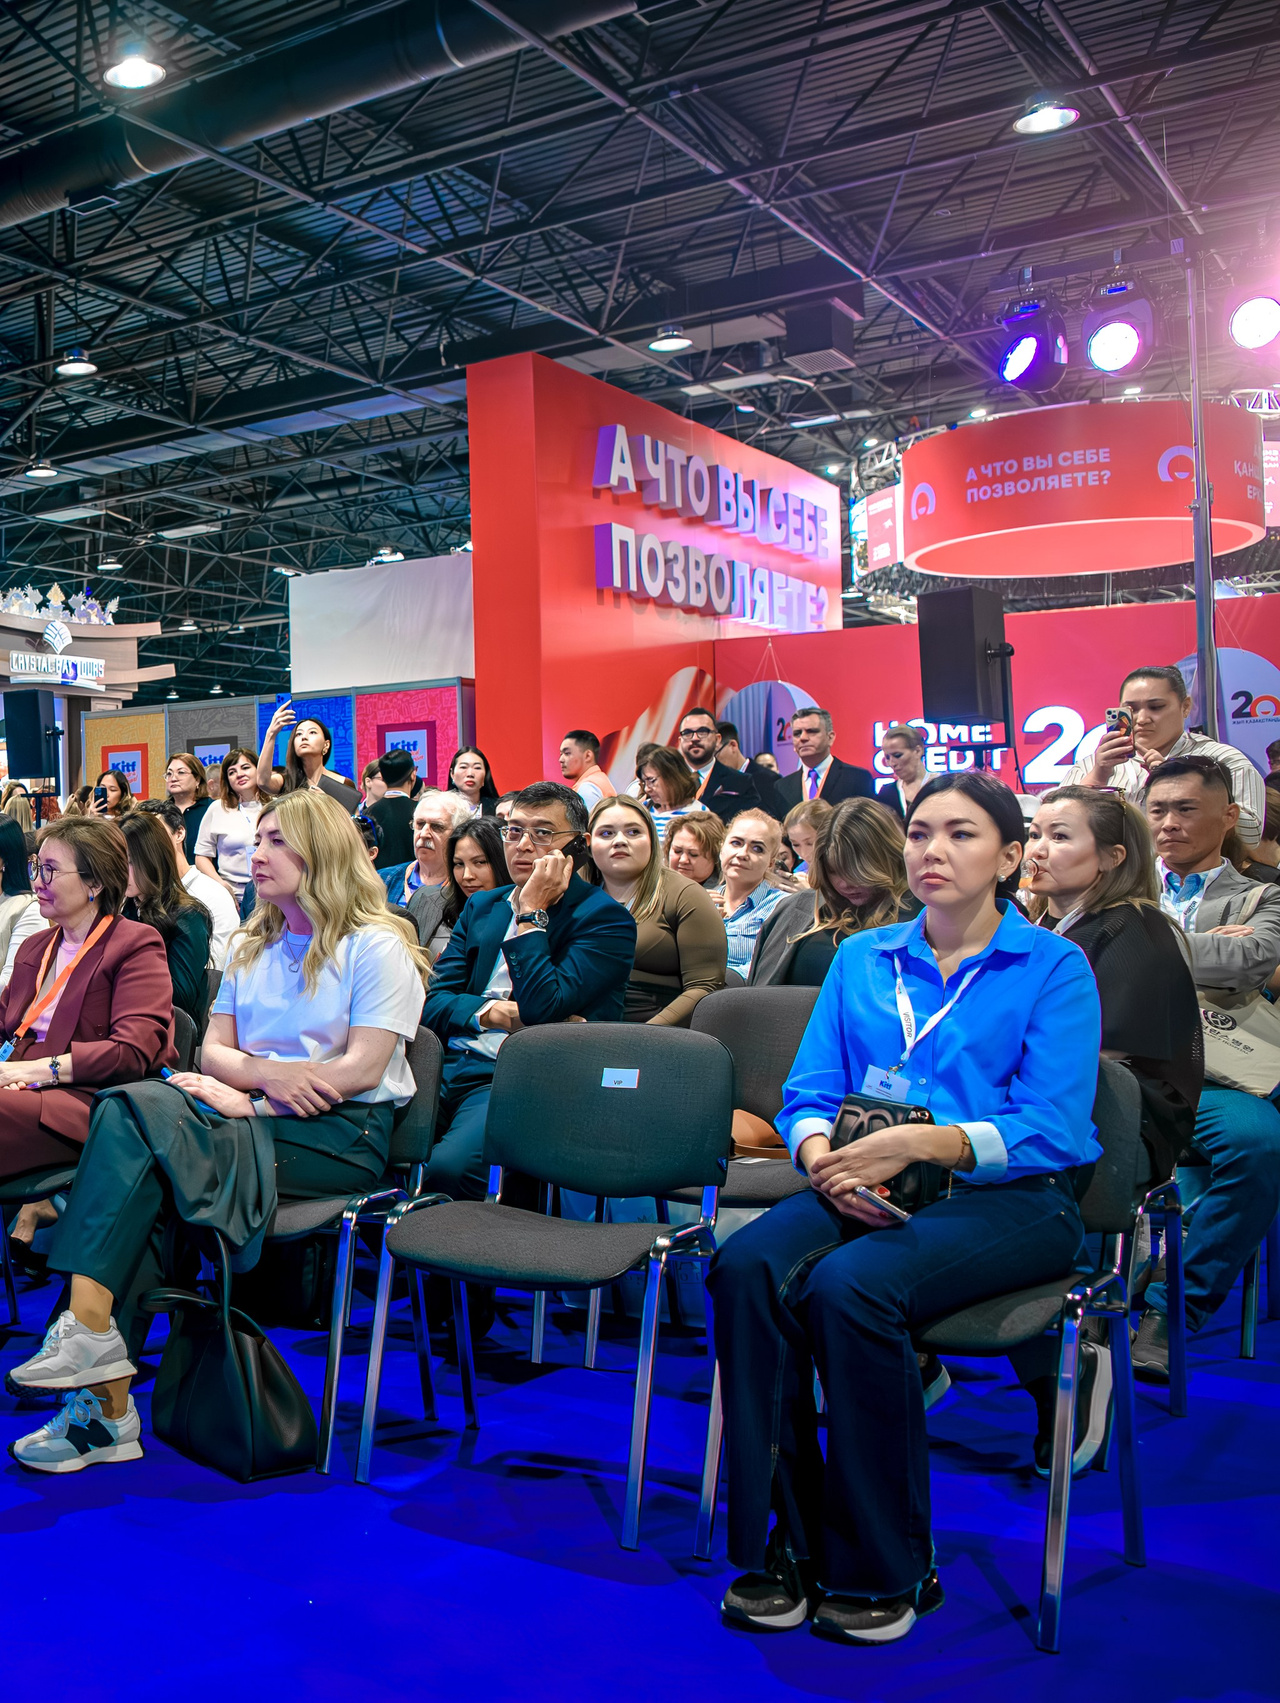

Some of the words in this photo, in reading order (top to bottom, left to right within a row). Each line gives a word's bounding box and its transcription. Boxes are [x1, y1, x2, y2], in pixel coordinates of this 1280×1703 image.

[966, 467, 978, 483] А
[981, 459, 1018, 478] ЧТО
[1023, 454, 1053, 472] ВЫ
[1058, 448, 1111, 467] СЕБЕ
[600, 424, 637, 494] А
[636, 434, 710, 516] ЧТО
[713, 464, 760, 535] ВЫ
[765, 487, 829, 557] СЕБЕ
[966, 470, 1112, 504] ПОЗВОЛЯЕТЕ?
[600, 522, 829, 633] ПОЗВОЛЯЕТЕ?
[11, 652, 54, 673] CRYSTAL
[111, 761, 136, 772] Kitf
[903, 1011, 912, 1038] VISITOR
